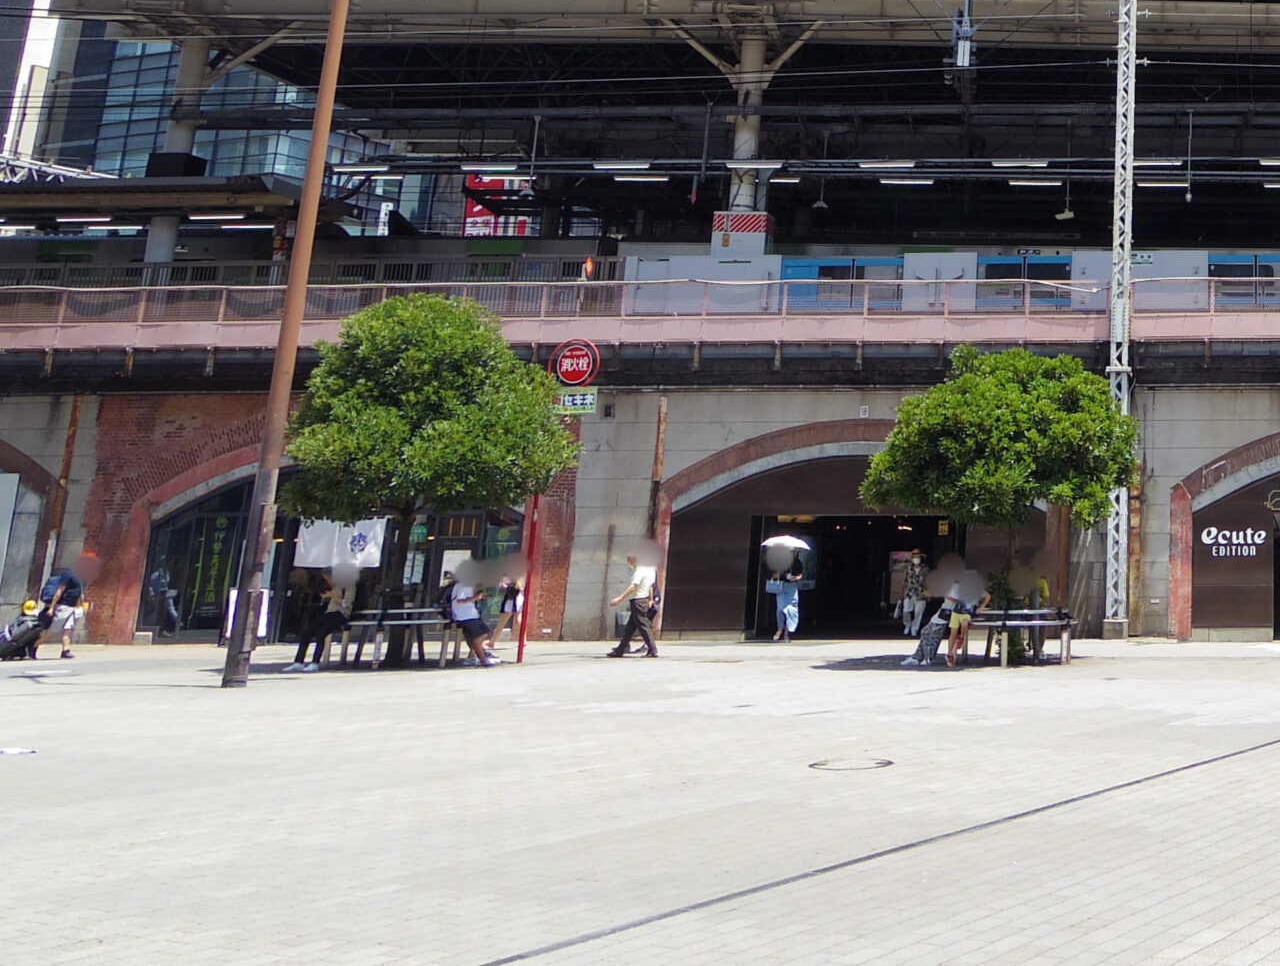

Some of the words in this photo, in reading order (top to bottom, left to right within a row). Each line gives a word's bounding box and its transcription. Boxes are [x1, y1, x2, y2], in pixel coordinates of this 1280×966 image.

[561, 357, 589, 372] 消火栓
[563, 393, 594, 406] セキネ
[1201, 526, 1267, 544] ecute
[1212, 545, 1256, 557] EDITION
